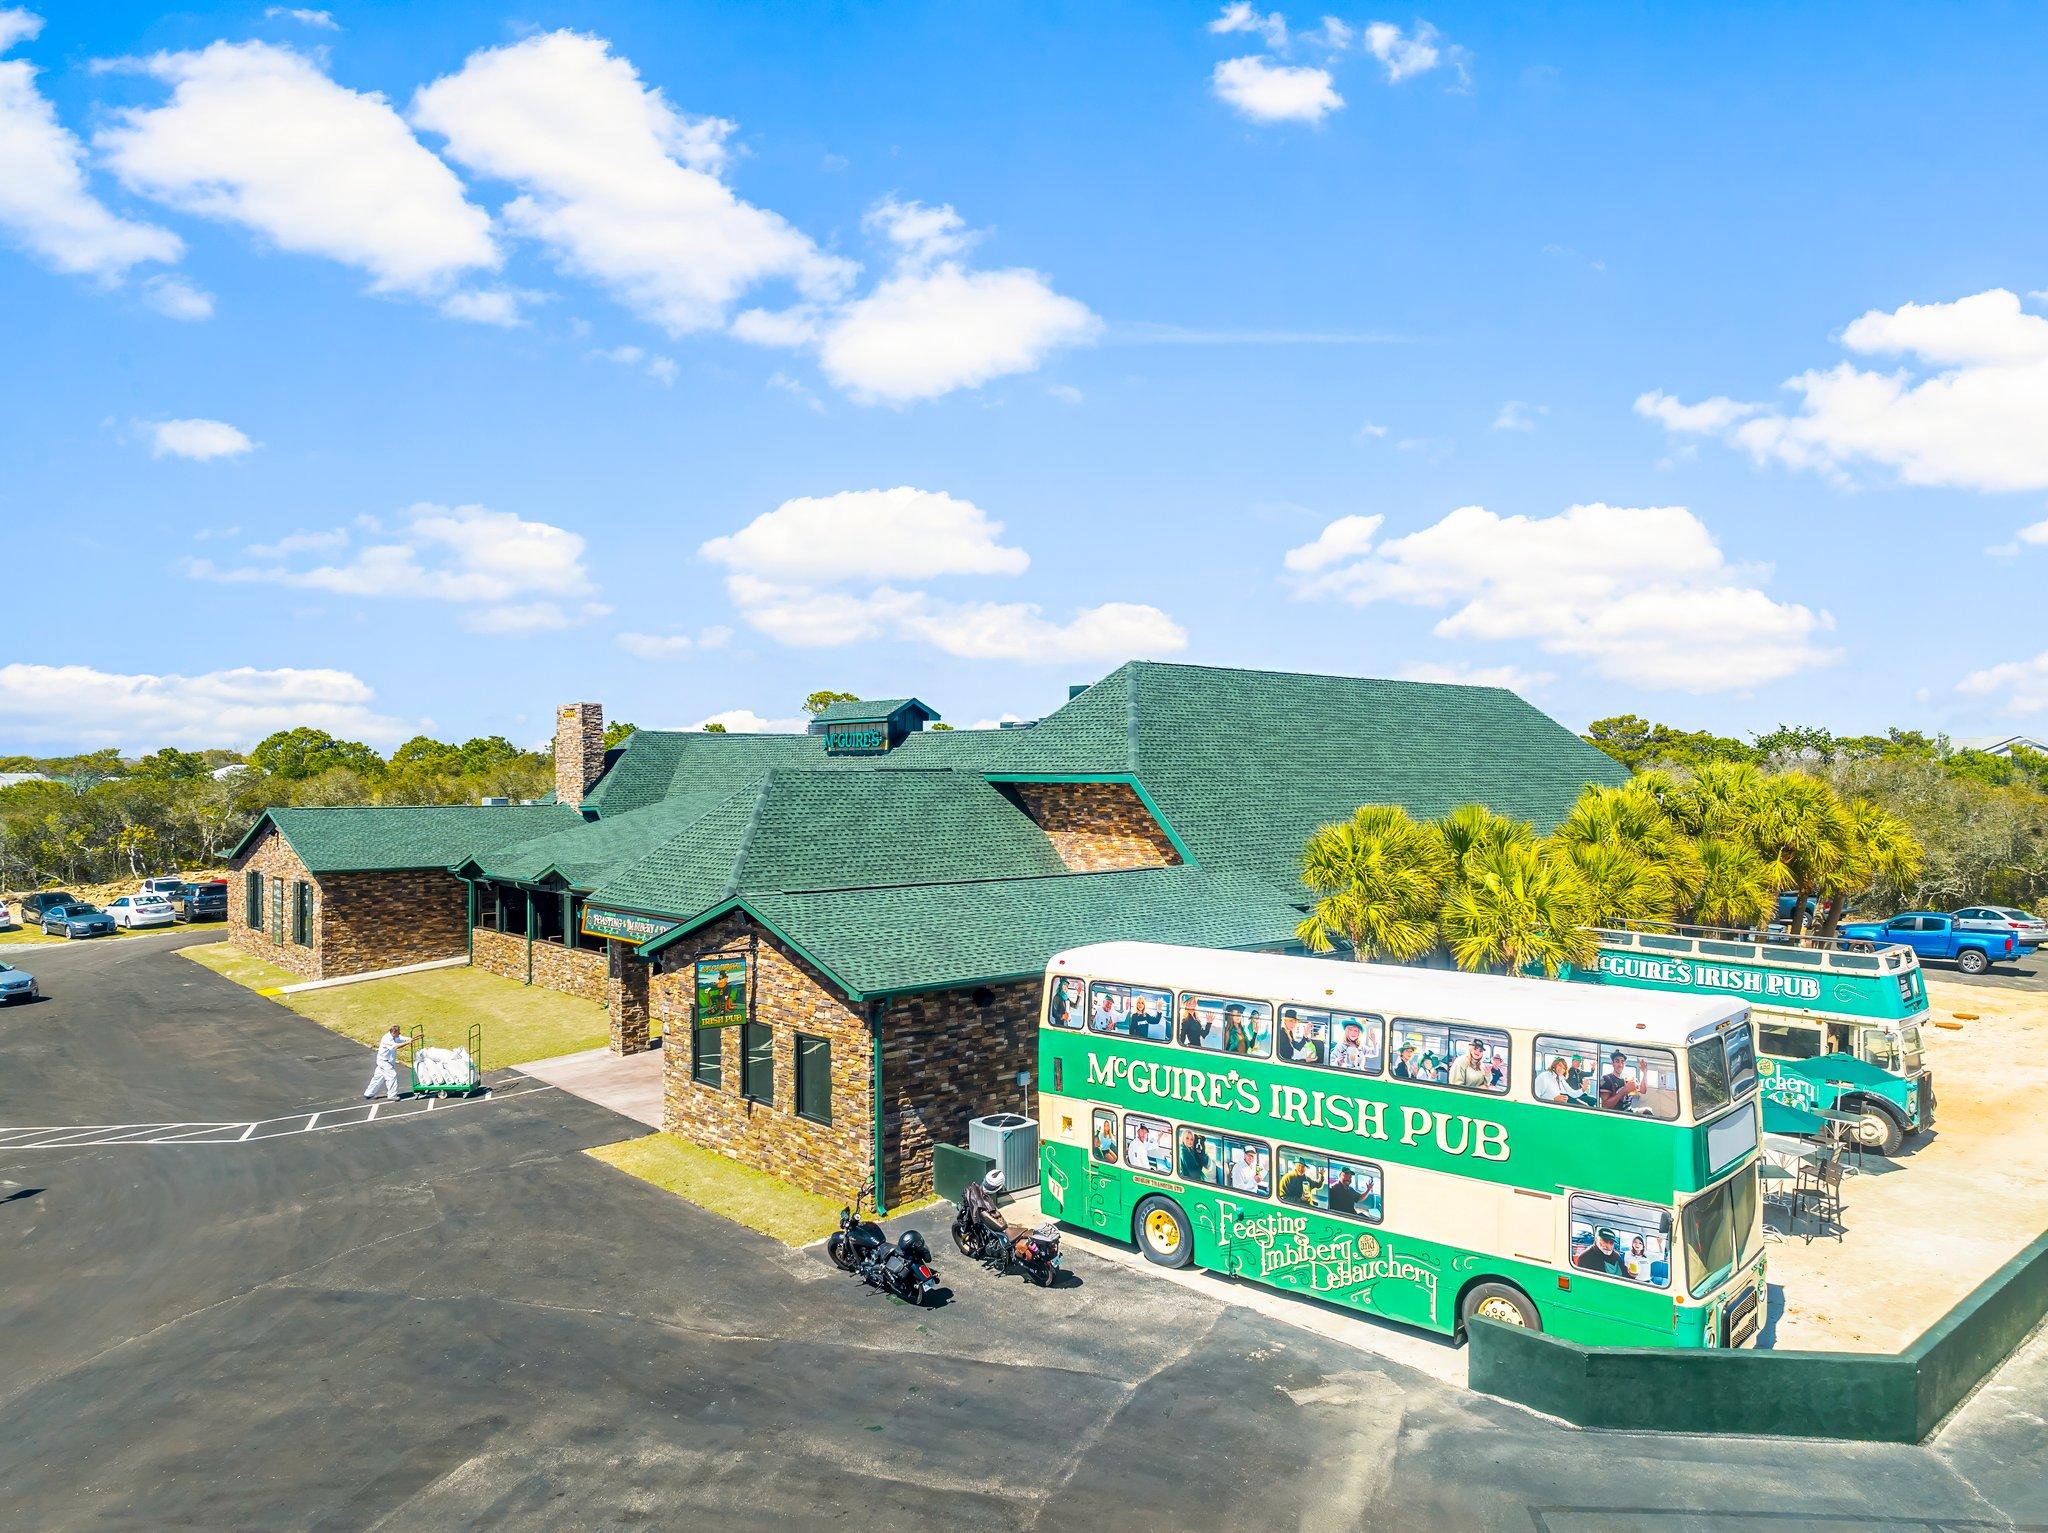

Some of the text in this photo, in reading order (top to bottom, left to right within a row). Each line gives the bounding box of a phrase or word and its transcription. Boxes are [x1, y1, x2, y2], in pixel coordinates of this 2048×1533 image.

[1697, 966, 1762, 992] IRISH
[1766, 974, 1820, 999] PUB
[725, 1014, 743, 1023] PUB
[1269, 1084, 1389, 1140] IRISH
[1400, 1105, 1511, 1162] PUB
[1215, 1199, 1309, 1247] Feasting
[1260, 1234, 1360, 1277] Imbibery
[1311, 1244, 1439, 1325] Debauchery
